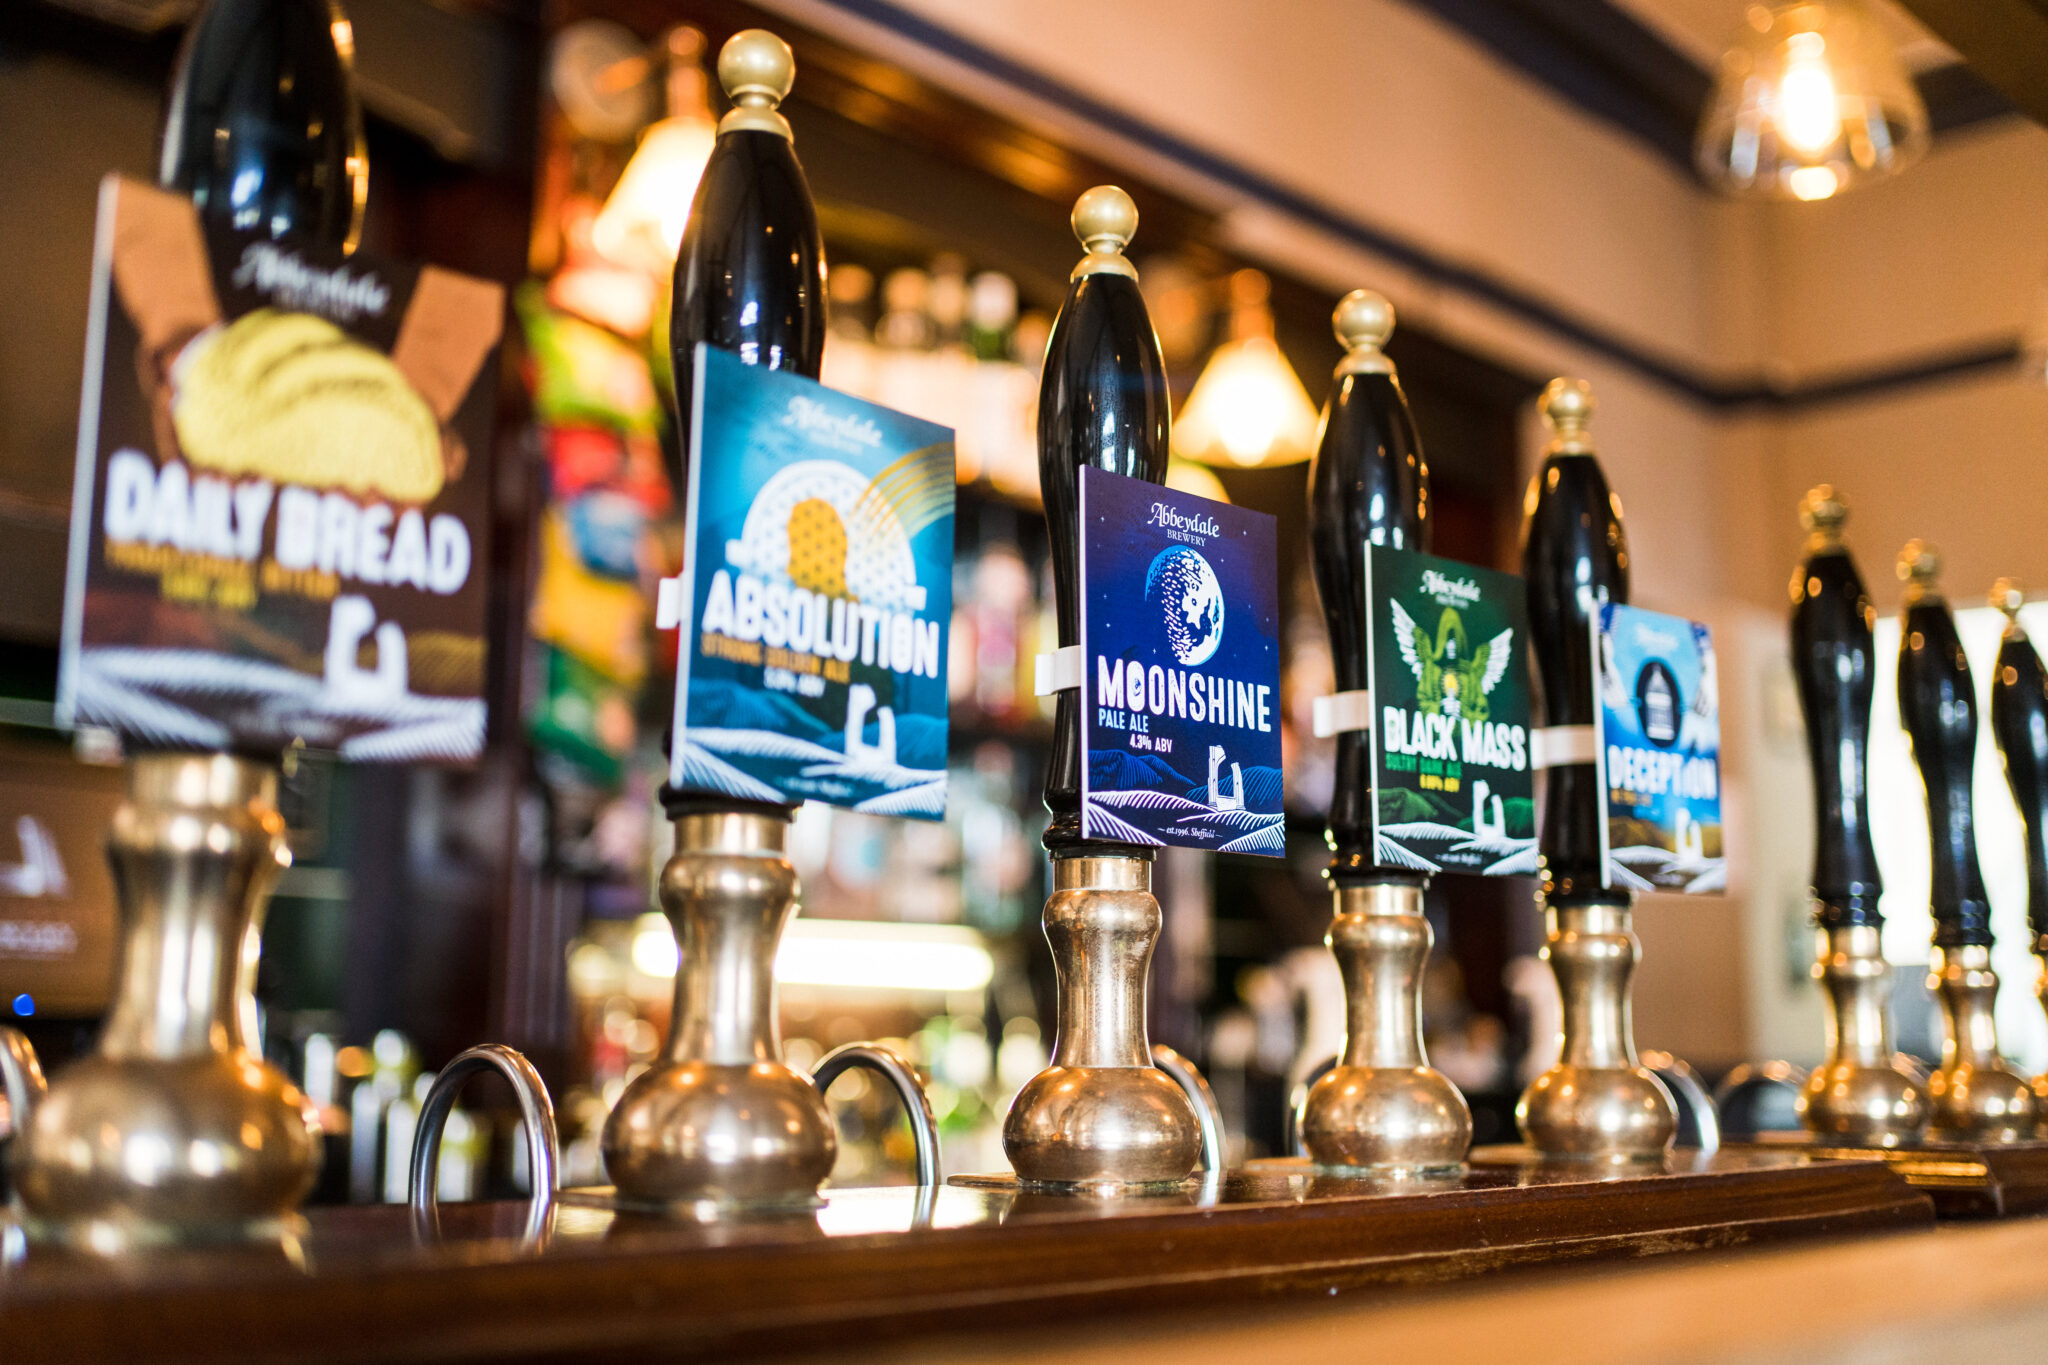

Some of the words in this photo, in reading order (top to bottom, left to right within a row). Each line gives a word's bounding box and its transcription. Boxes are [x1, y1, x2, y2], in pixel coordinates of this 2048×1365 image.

[104, 448, 275, 562] DAILY
[275, 484, 471, 594] BREAD
[1147, 502, 1220, 538] Abbeydale
[1167, 529, 1206, 547] BREWERY
[701, 569, 940, 679] ABSOLUTION
[1098, 655, 1271, 732] MOONSHINE
[1098, 708, 1126, 730] PALE
[1129, 713, 1149, 733] ALE
[1130, 733, 1152, 751] 4.3%
[1154, 737, 1173, 753] ABV
[1383, 705, 1458, 762] BLACK
[1461, 717, 1527, 772] MASS
[1608, 744, 1717, 800] DECEPTION
